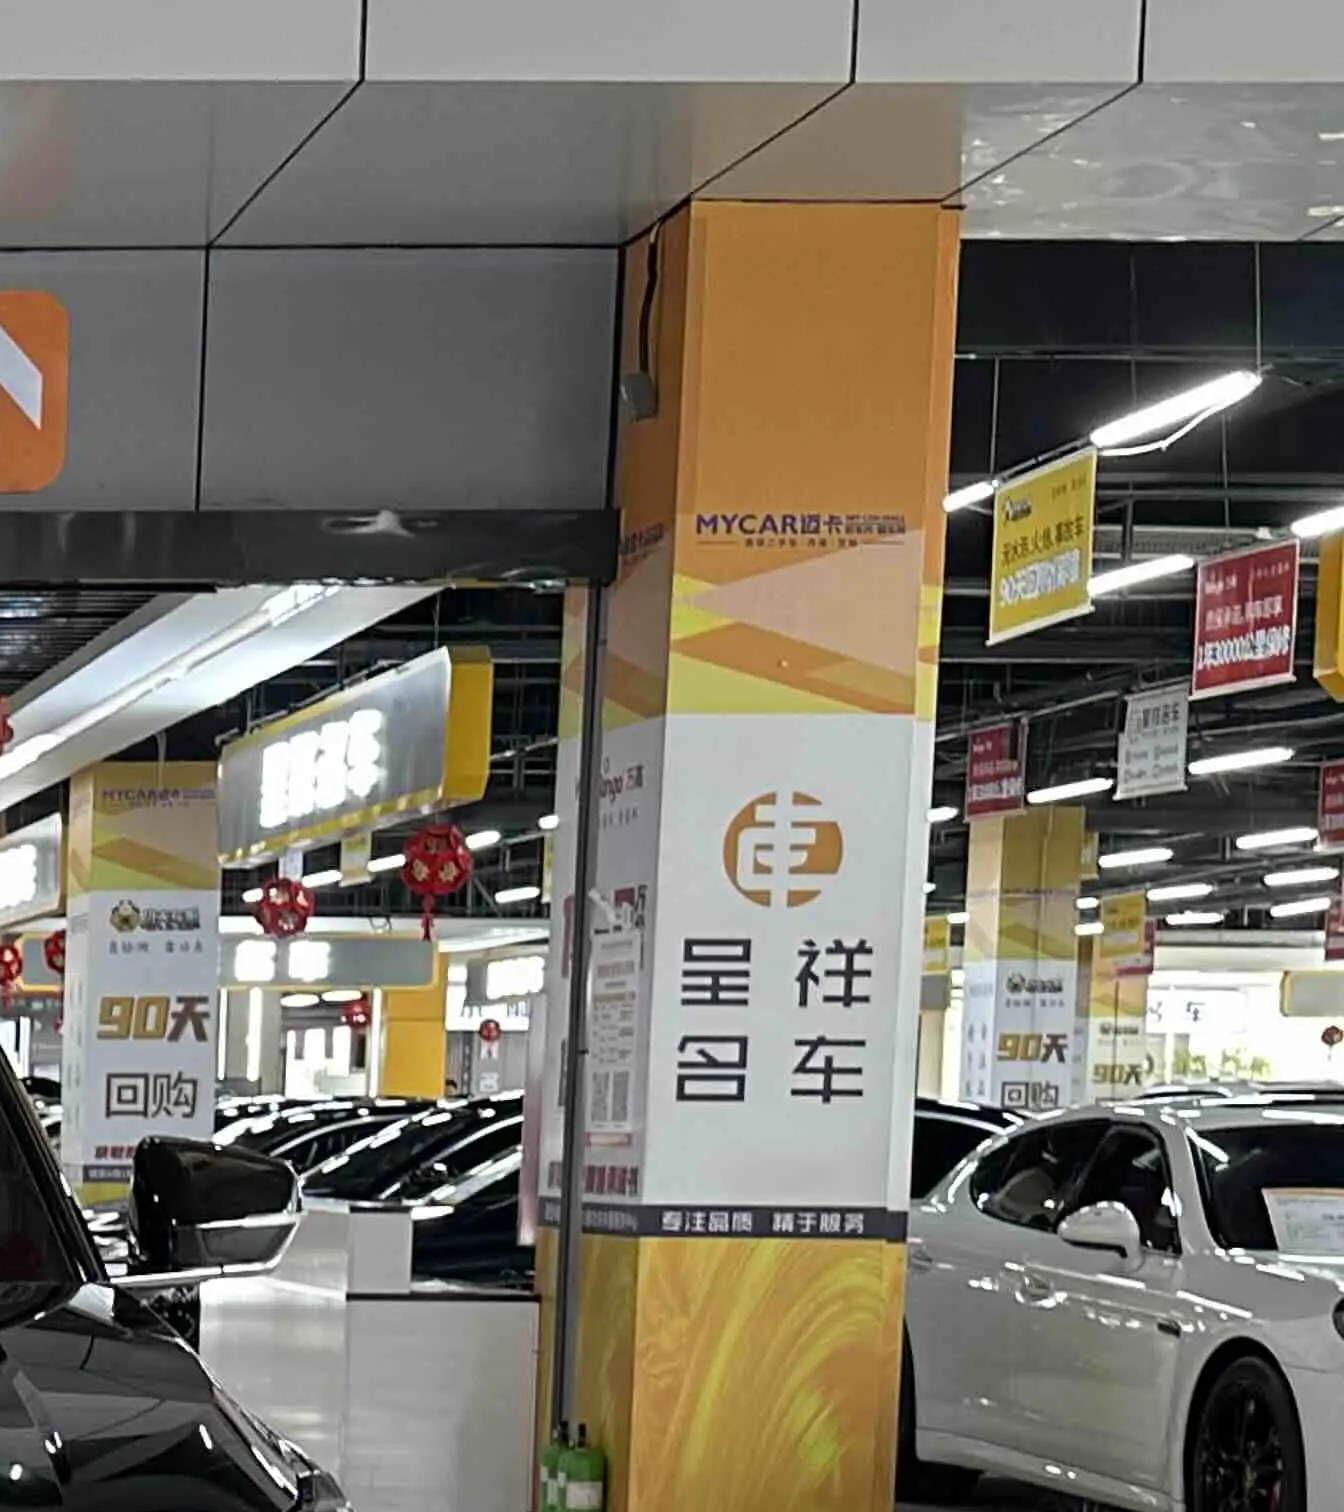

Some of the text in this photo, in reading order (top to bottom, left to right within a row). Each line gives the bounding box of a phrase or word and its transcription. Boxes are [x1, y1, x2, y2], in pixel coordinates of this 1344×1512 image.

[679, 937, 874, 1008] 呈祥
[96, 994, 211, 1043] 90天
[675, 1034, 866, 1104] 名车
[996, 1032, 1068, 1064] 90天
[105, 1071, 199, 1119] 回购
